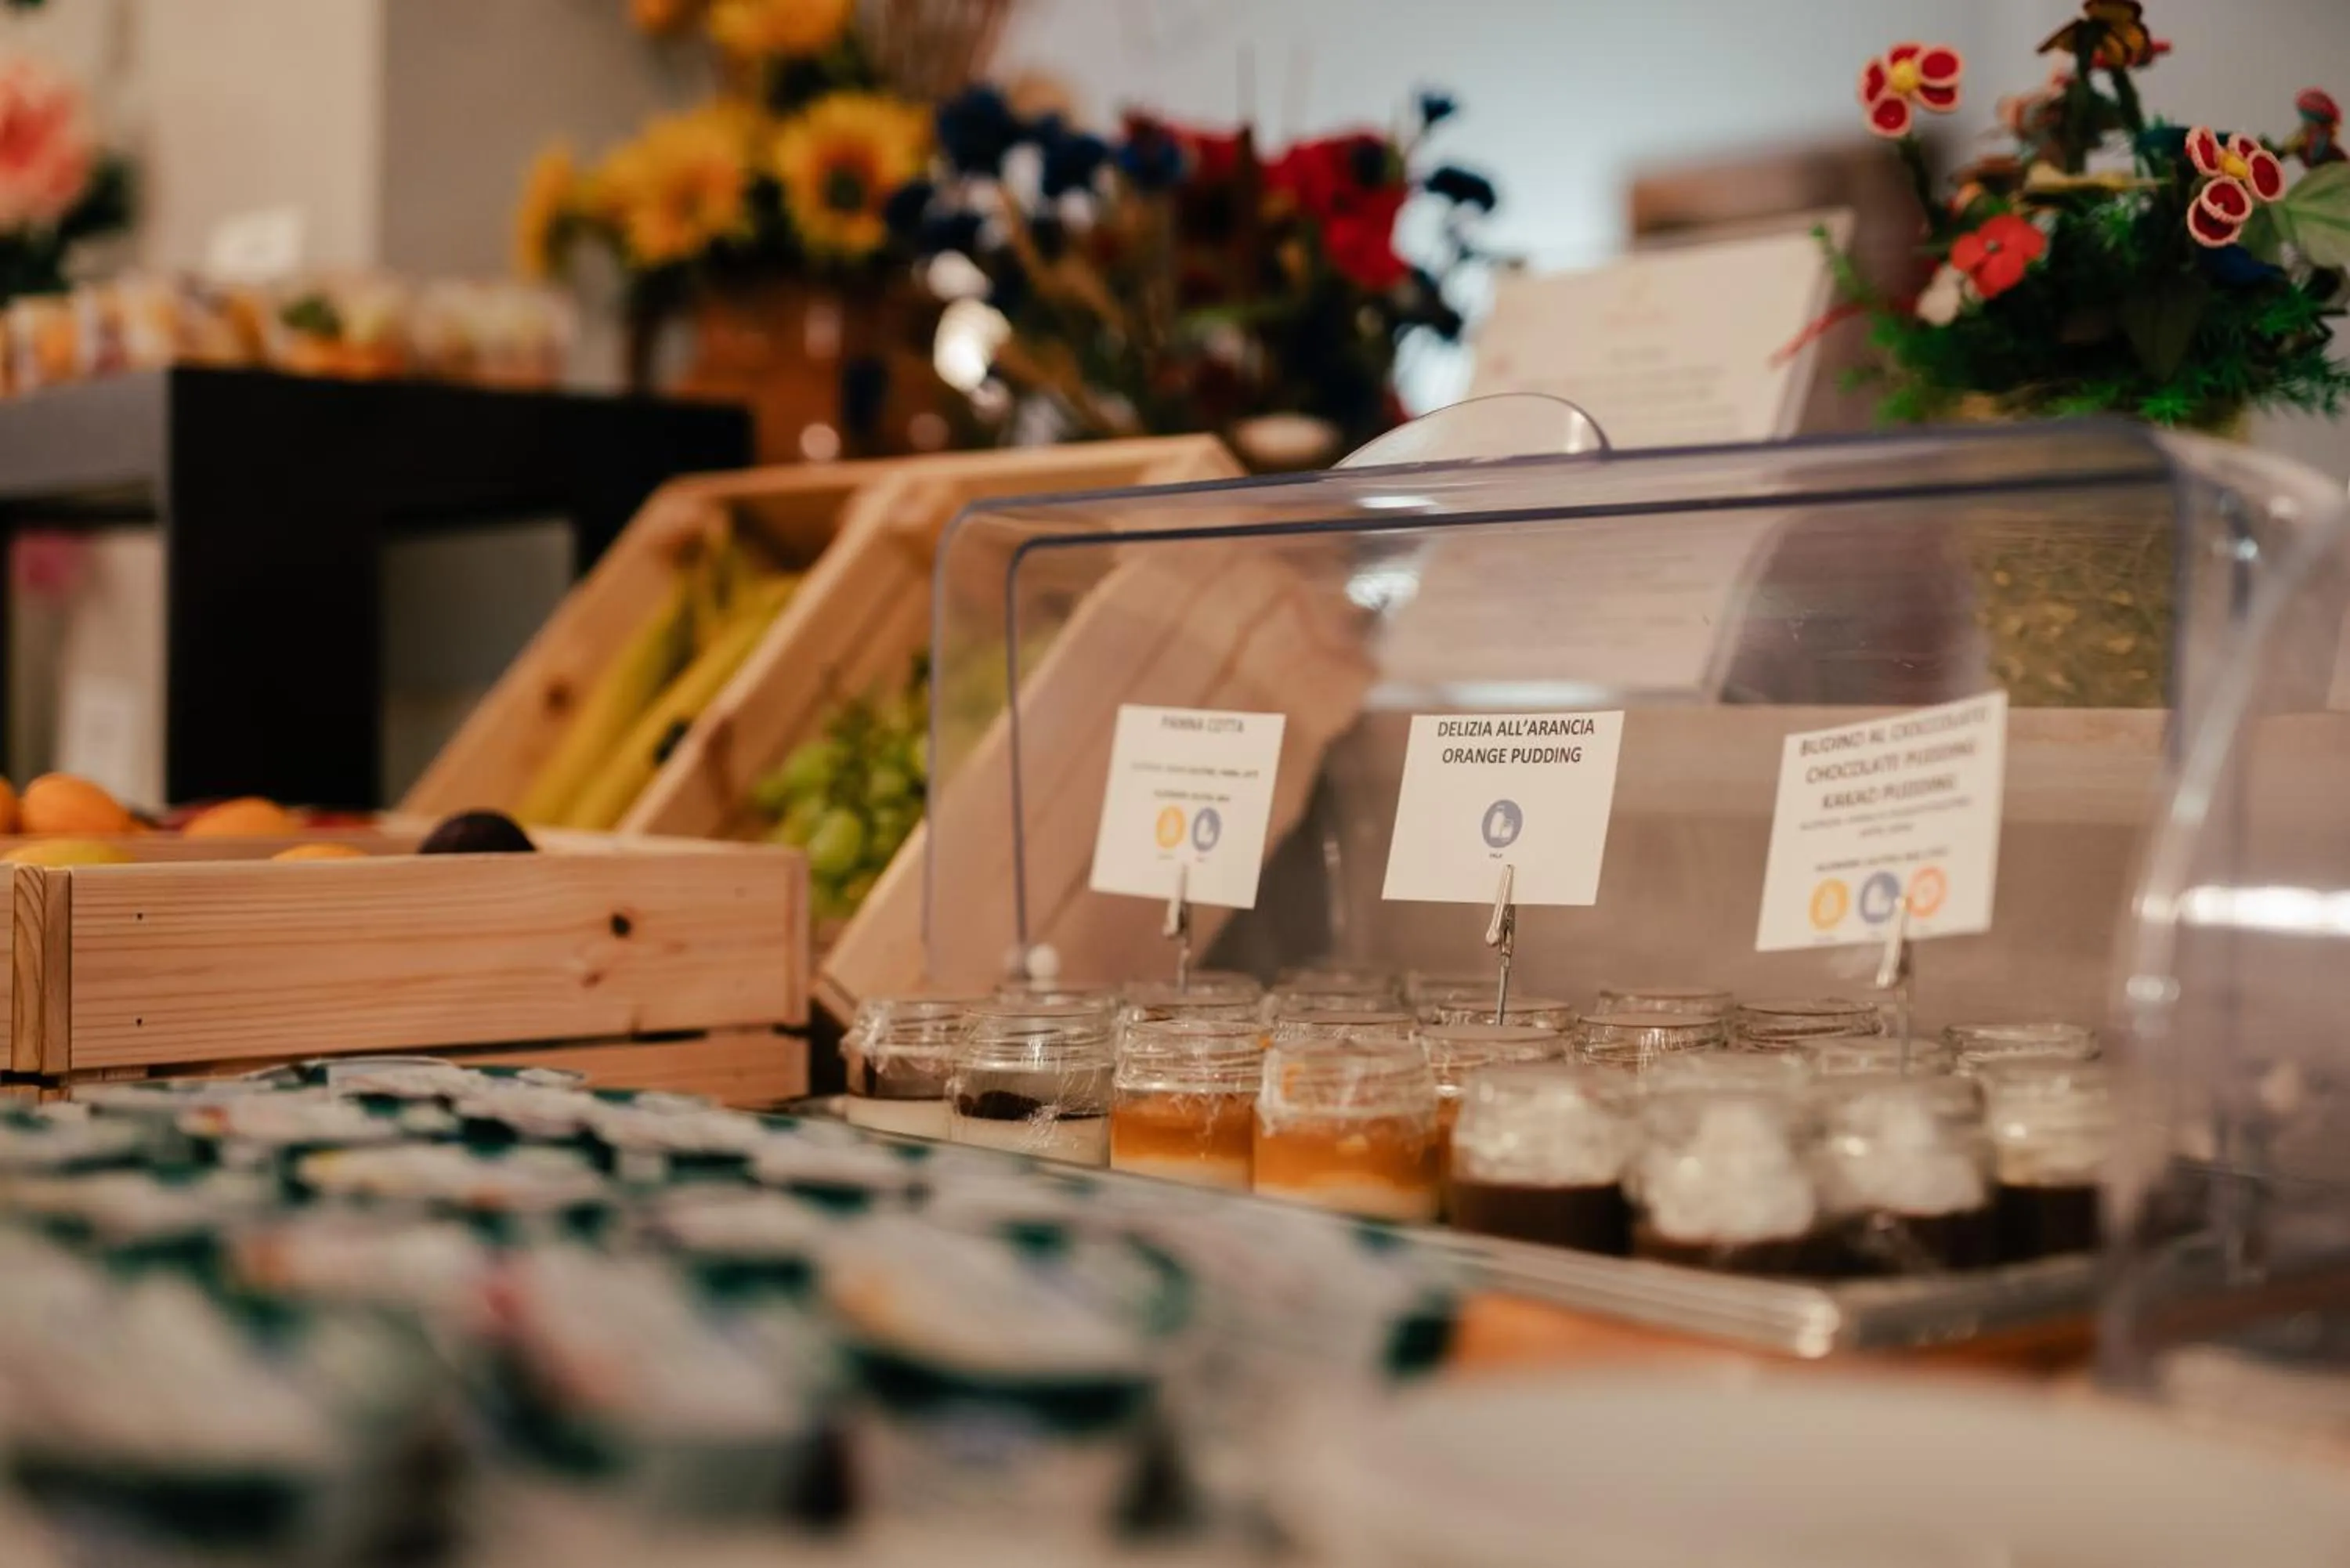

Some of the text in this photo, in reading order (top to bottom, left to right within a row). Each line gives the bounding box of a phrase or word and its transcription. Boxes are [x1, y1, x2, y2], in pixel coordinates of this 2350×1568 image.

[1437, 719, 1595, 737] DELIZIA ALL'ARANCIA
[1442, 746, 1582, 764] ORANGE PUDDING
